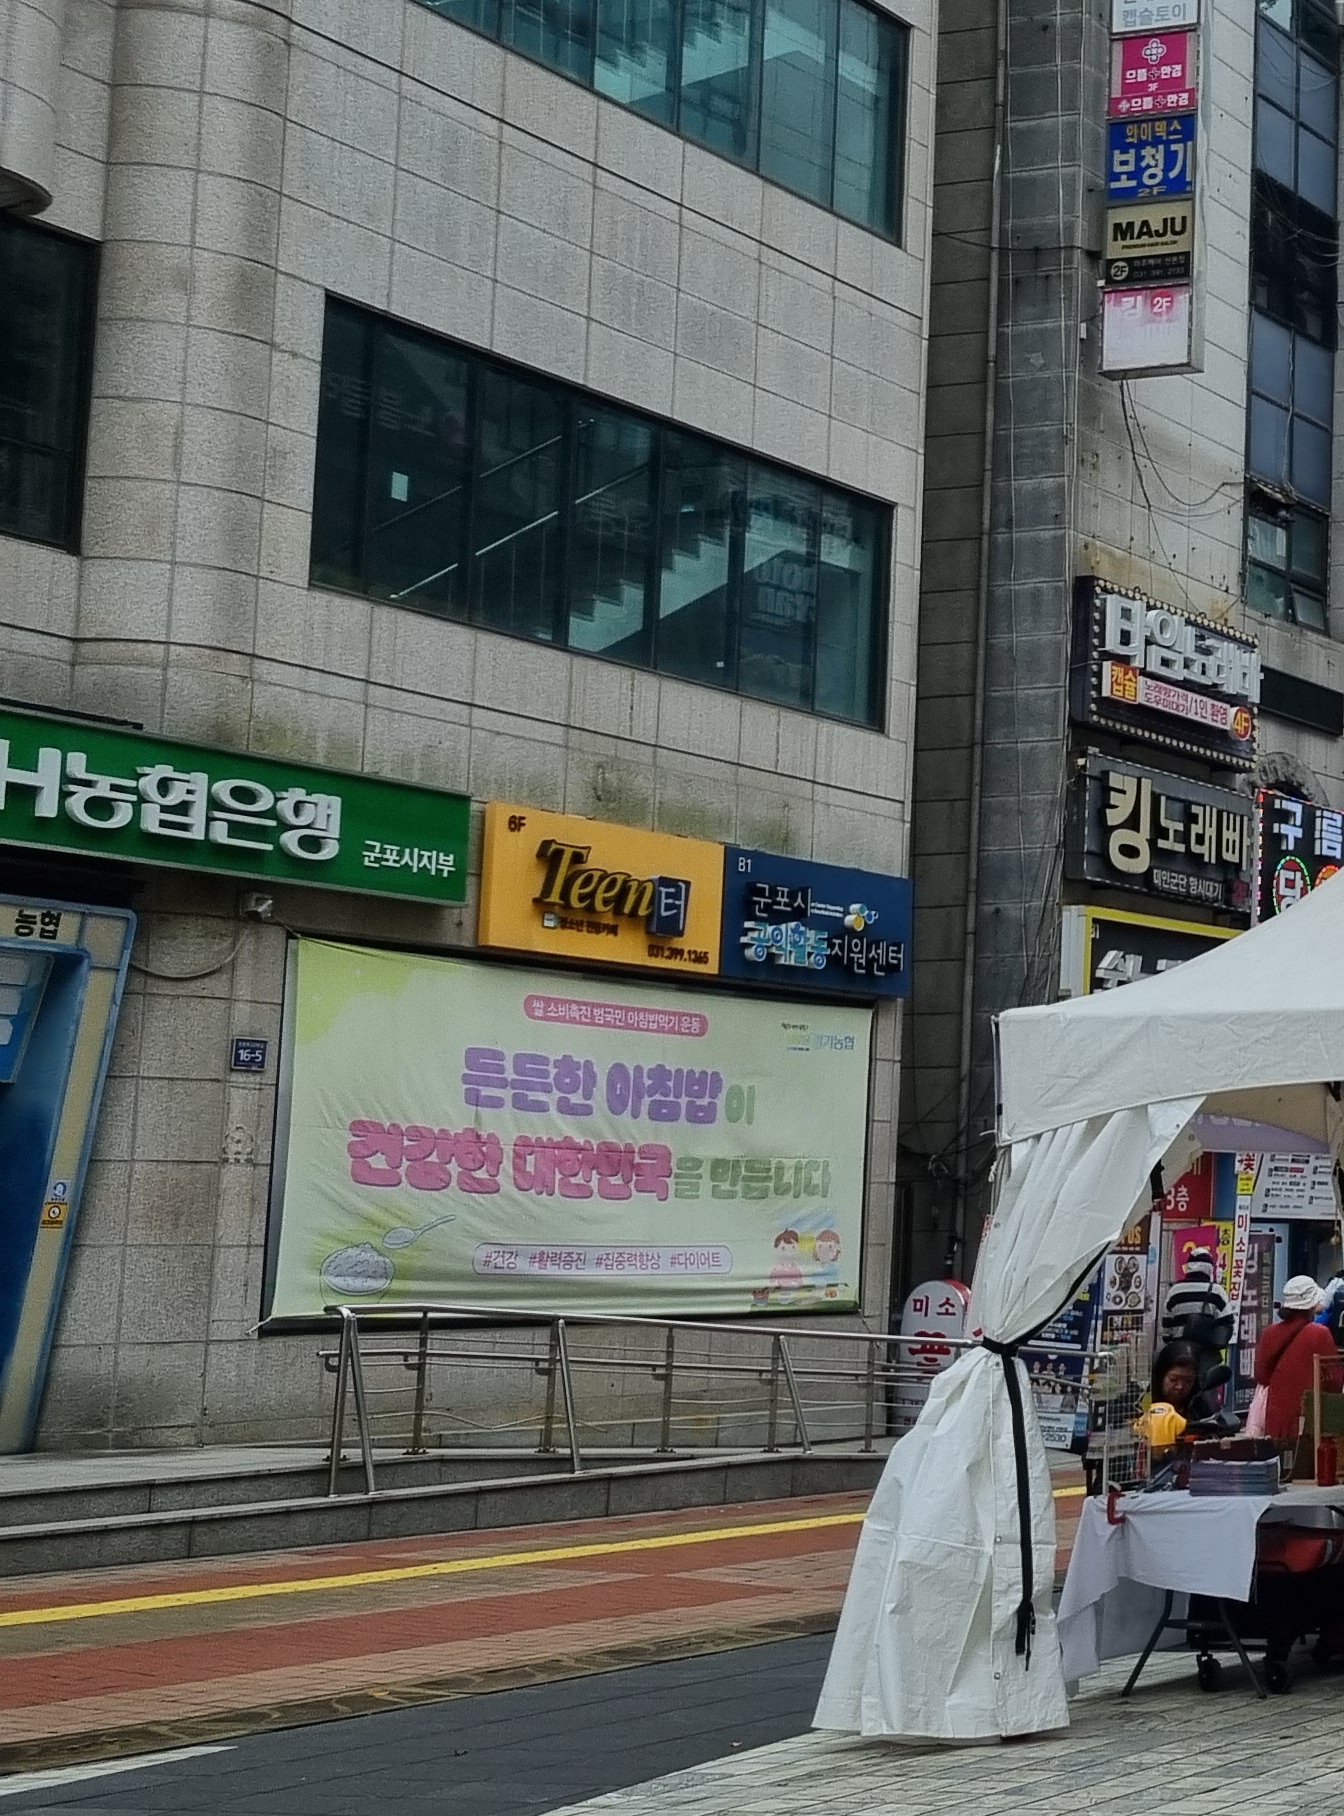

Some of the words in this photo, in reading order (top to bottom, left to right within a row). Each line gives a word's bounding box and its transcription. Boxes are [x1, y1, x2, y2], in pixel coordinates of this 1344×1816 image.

[1122, 3, 1186, 27] 캡슐토이
[1110, 141, 1193, 189] 보청기
[1137, 186, 1167, 197] 2F
[1112, 216, 1187, 242] MAJU
[1112, 265, 1129, 279] 2F
[1152, 297, 1171, 312] 2F
[1110, 664, 1137, 702] 캡슐
[1211, 703, 1228, 726] 환영
[1232, 712, 1249, 735] 4F
[0, 738, 342, 861] H농협은행
[362, 839, 456, 878] 군포시지부
[508, 814, 527, 834] 6F
[1105, 771, 1250, 875] 킹노래빠
[1273, 799, 1343, 860] 구름
[738, 857, 753, 874] B1
[1153, 868, 1188, 893] 미인군단
[1188, 876, 1222, 901] 항시대기
[752, 882, 812, 918] 군포시
[14, 909, 62, 941] 농협
[647, 943, 710, 965] 031.399.1365
[740, 920, 906, 975] 공익활동지원센터
[532, 999, 545, 1017] 쌀
[546, 1001, 592, 1023] 소비촉진
[593, 1006, 626, 1027] 범국민
[627, 1010, 679, 1032] 아침밥먹기
[680, 1014, 701, 1034] 운동
[238, 1049, 263, 1063] 16-5
[462, 1046, 597, 1118] 든든한
[346, 1119, 504, 1195] 건강한
[512, 1134, 704, 1202] 대한민국을
[709, 1157, 833, 1200] 만듭니다
[1165, 1184, 1190, 1212] 3층
[482, 1248, 519, 1269] #건강
[528, 1249, 588, 1270] #활력증진
[594, 1250, 662, 1271] #집중력향상
[669, 1251, 722, 1270] #다이어트
[1231, 1213, 1249, 1302] 미소꽃집
[912, 1294, 957, 1318] 미소
